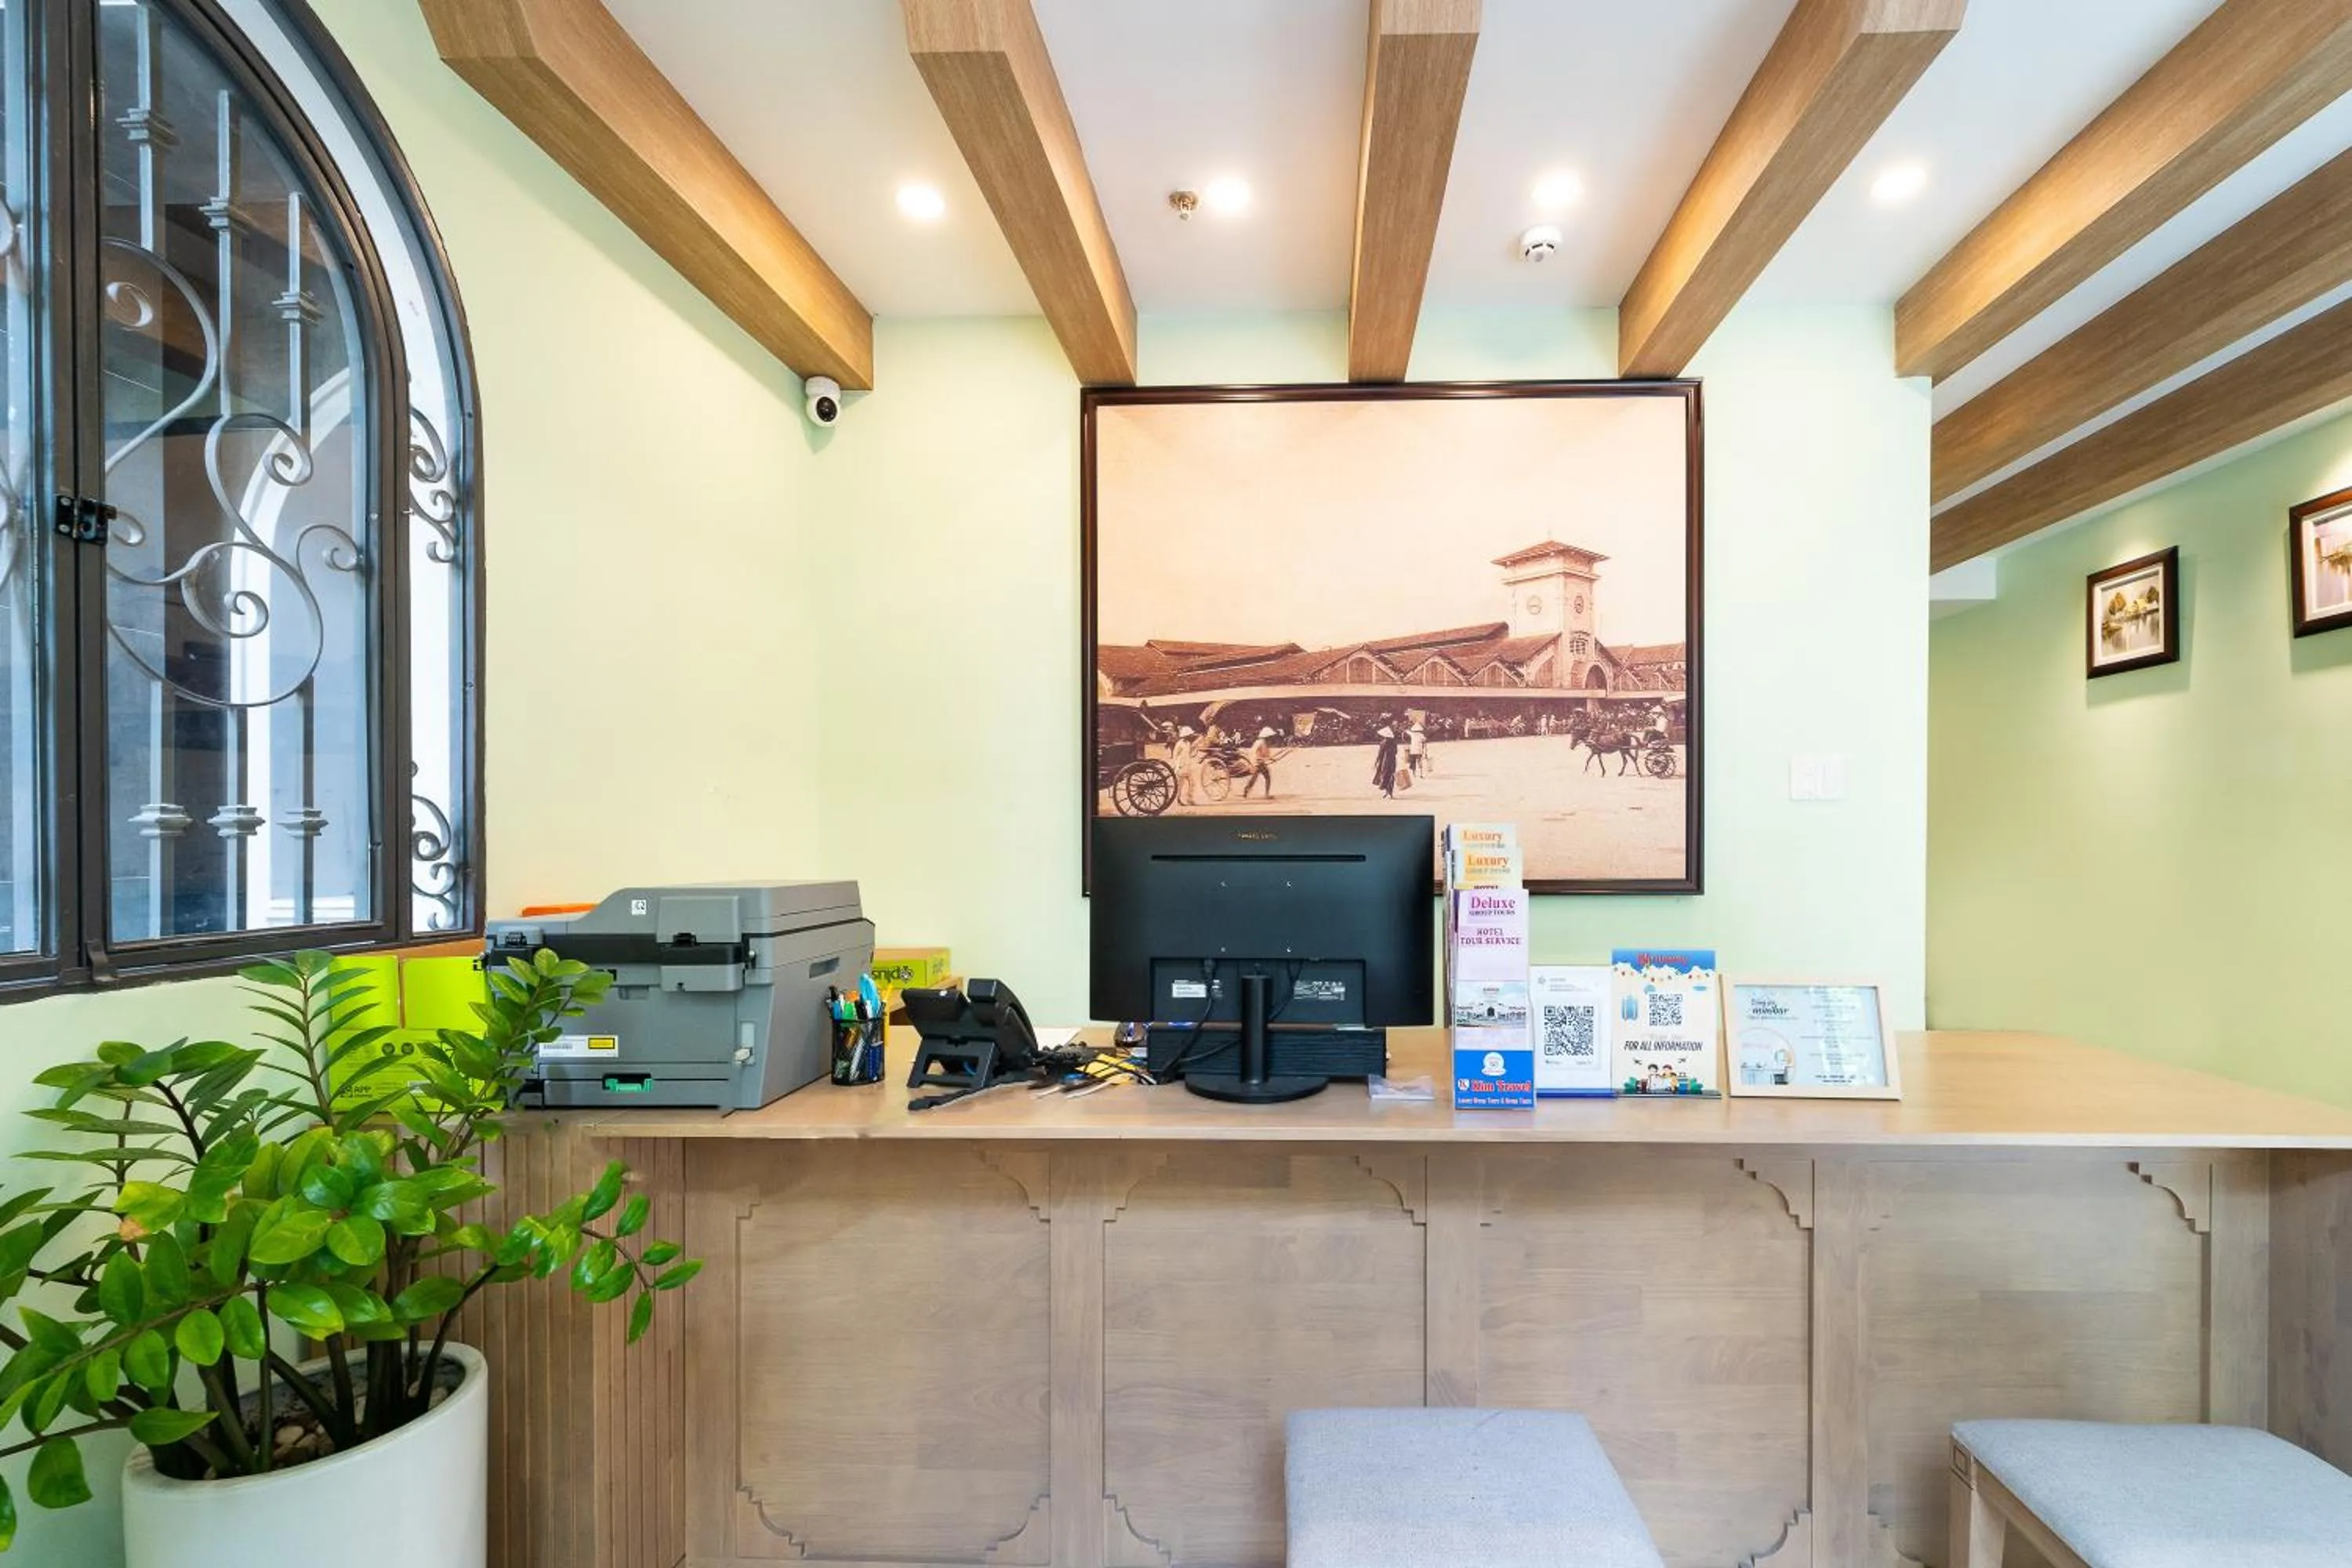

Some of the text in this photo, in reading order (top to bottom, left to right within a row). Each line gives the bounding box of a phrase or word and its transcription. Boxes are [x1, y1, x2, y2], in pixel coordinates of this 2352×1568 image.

[1462, 829, 1504, 844] Luxury
[1467, 855, 1509, 868] Luxury
[1471, 896, 1516, 909] Deluxe
[1460, 937, 1521, 946] TOUR SERVICE
[1624, 1040, 1704, 1051] FOR ALL INFORMATION
[1496, 1079, 1531, 1092] Travel
